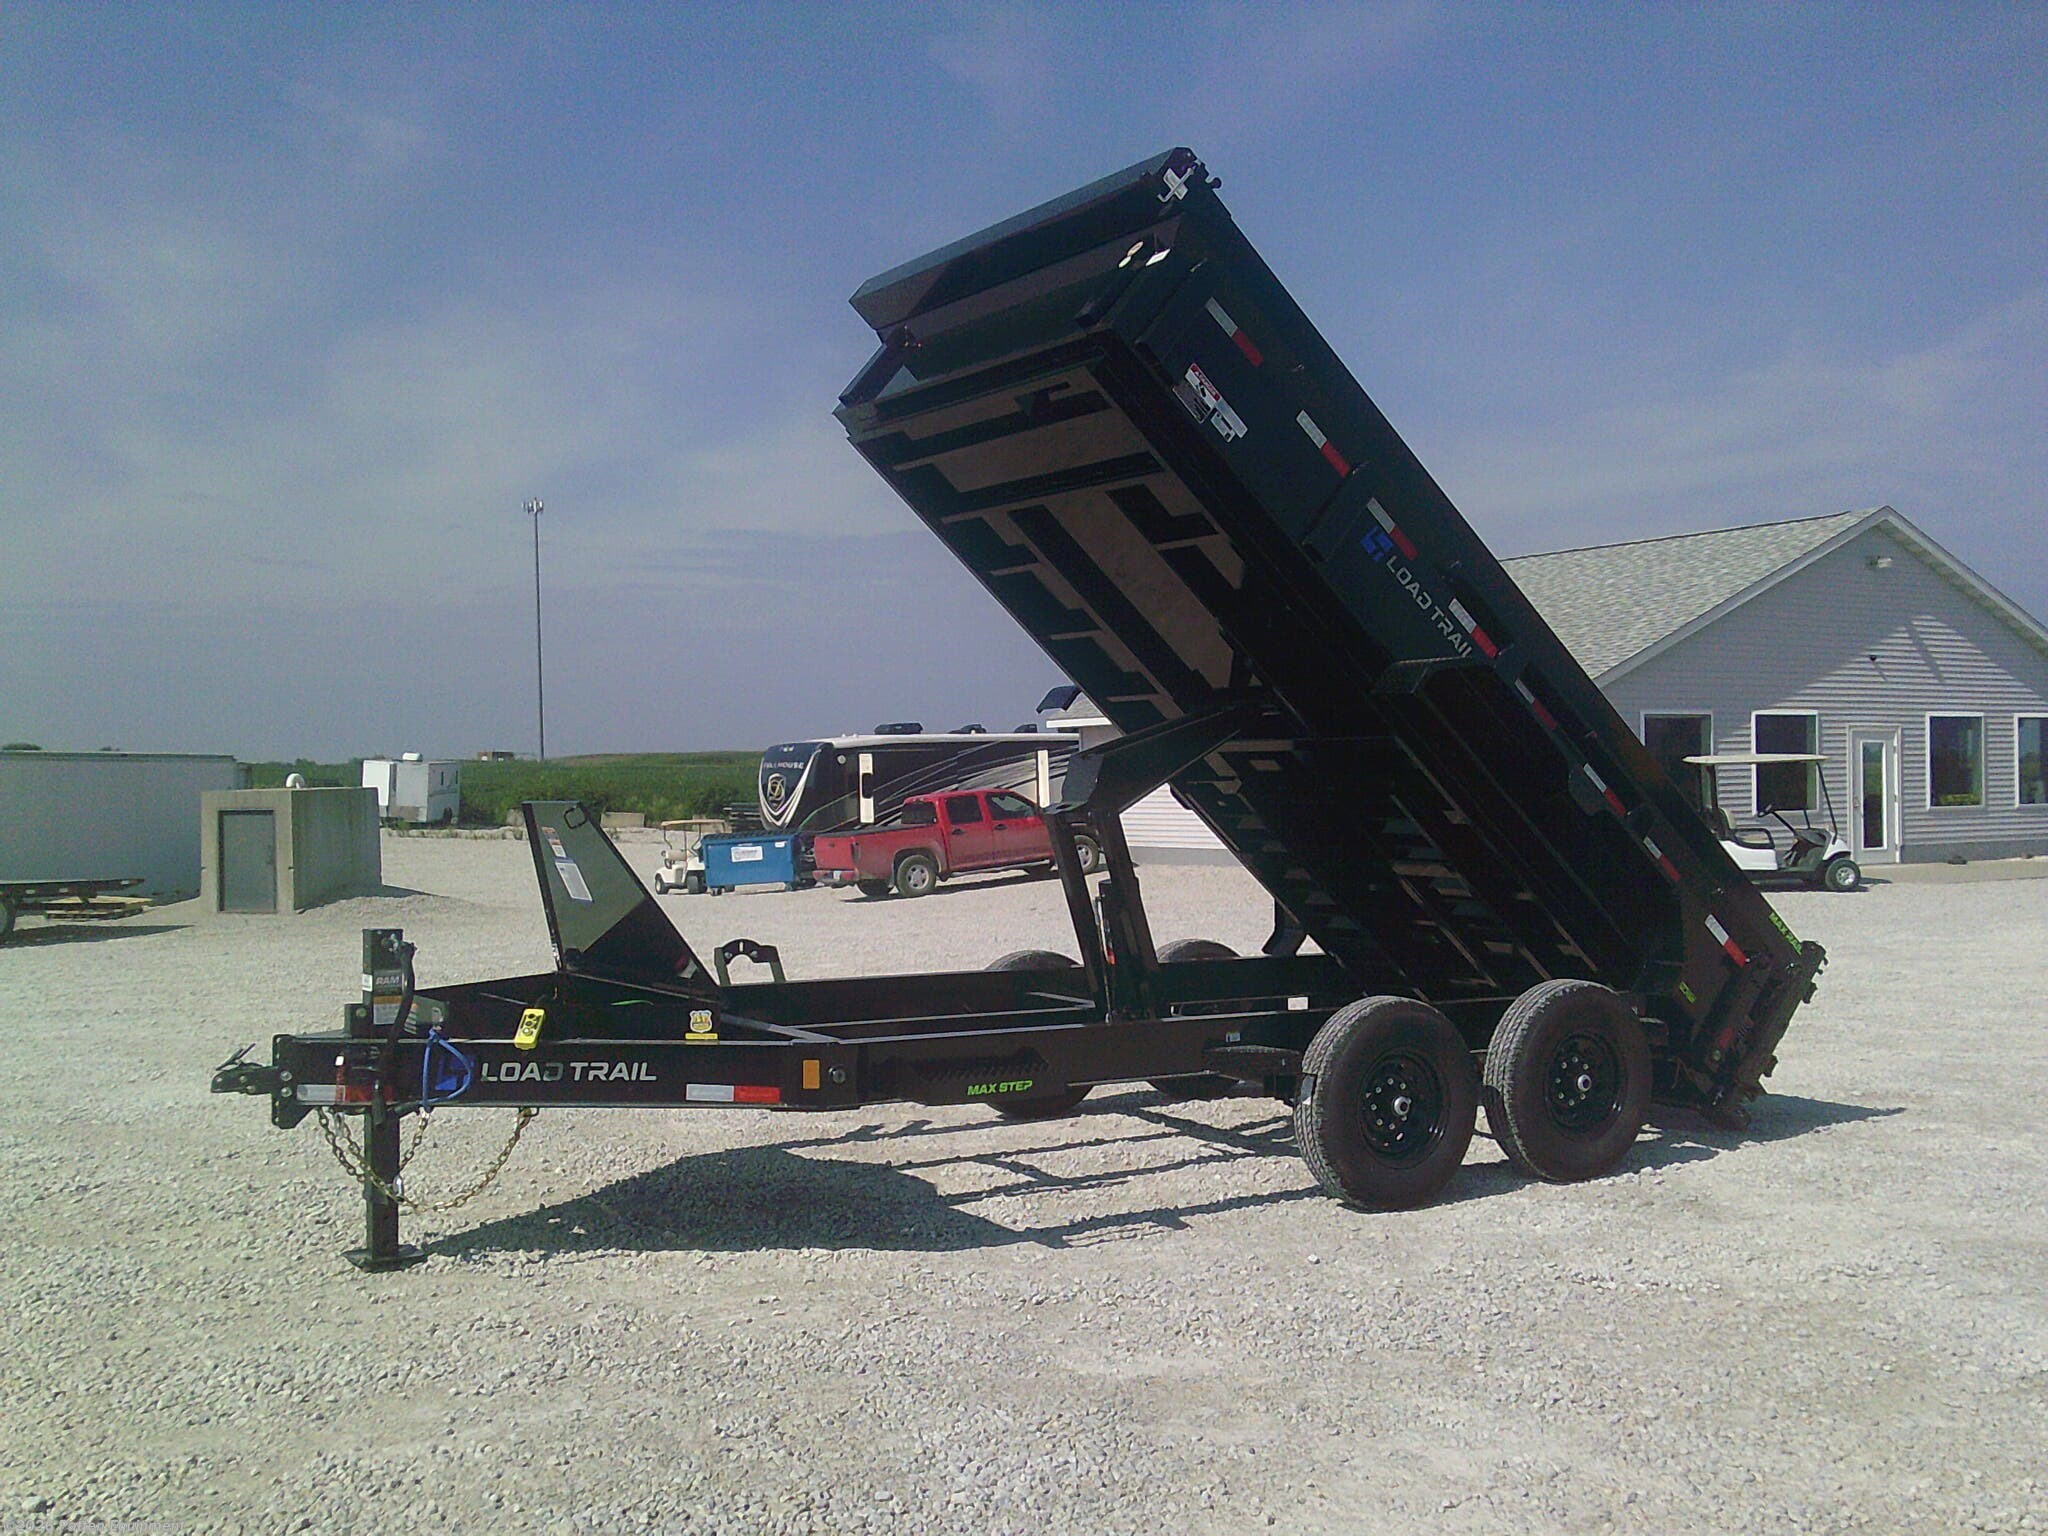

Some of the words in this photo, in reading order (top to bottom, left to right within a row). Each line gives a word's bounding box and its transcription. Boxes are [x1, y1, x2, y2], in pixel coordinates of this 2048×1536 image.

[1386, 555, 1432, 610] LOAD
[375, 975, 400, 986] RAM
[480, 1062, 563, 1082] LOAD
[570, 1062, 657, 1082] TRAIL
[967, 1082, 997, 1096] MAX
[999, 1080, 1033, 1094] STEP
